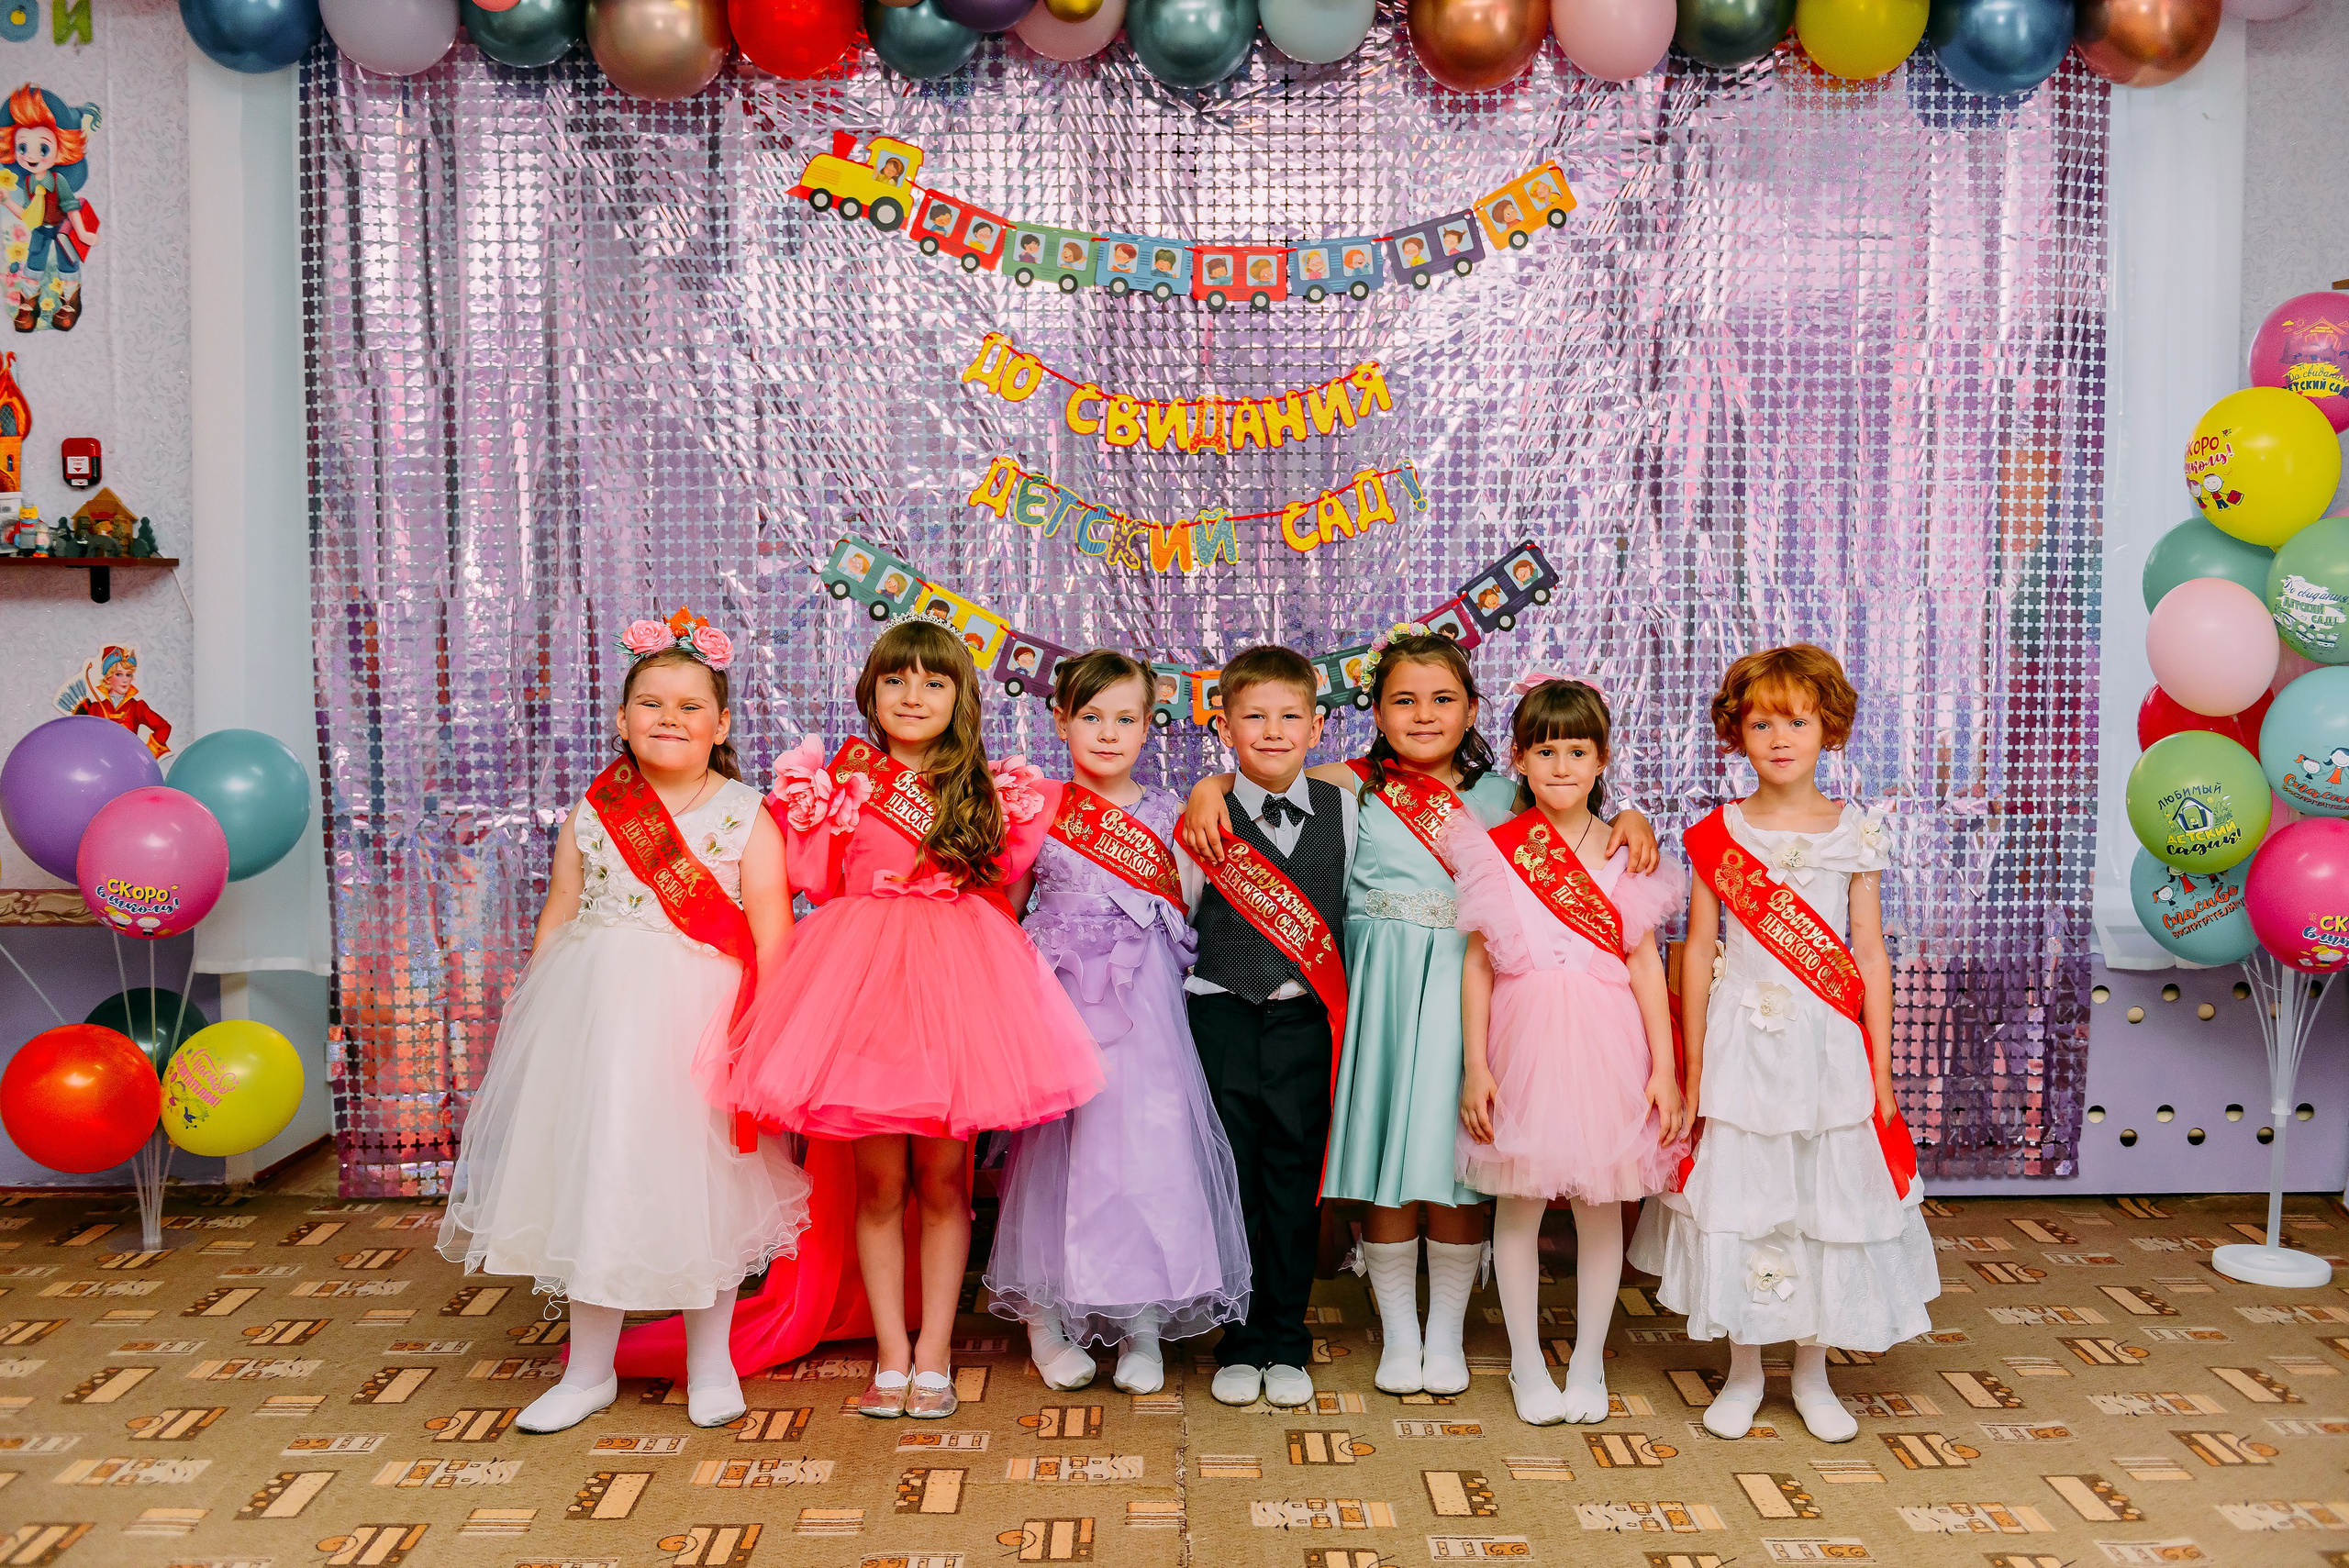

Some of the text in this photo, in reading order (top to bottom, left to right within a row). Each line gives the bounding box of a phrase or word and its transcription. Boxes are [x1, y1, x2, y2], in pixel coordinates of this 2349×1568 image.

[963, 332, 1392, 454] ДО СВИДАНИЯ
[2282, 378, 2326, 392] ЕТСКИЙ
[2185, 436, 2220, 457] КОРО
[968, 456, 1239, 573] ДЕТСКИЙ
[884, 791, 934, 834] ДЕТСКО
[2157, 782, 2221, 810] ЛЮБИМЫЙ
[637, 801, 704, 897] Выпускник
[1094, 832, 1158, 881] ДЕТСКОГО
[2166, 819, 2236, 844] ДЕТСКИЙ
[107, 878, 171, 904] СКОРО
[1220, 863, 1278, 918] ДЕТСКОГО
[1226, 842, 1319, 941] Выпускник
[1757, 912, 1820, 970] ДЕТСКОГО
[1767, 889, 1860, 991] Выпускник
